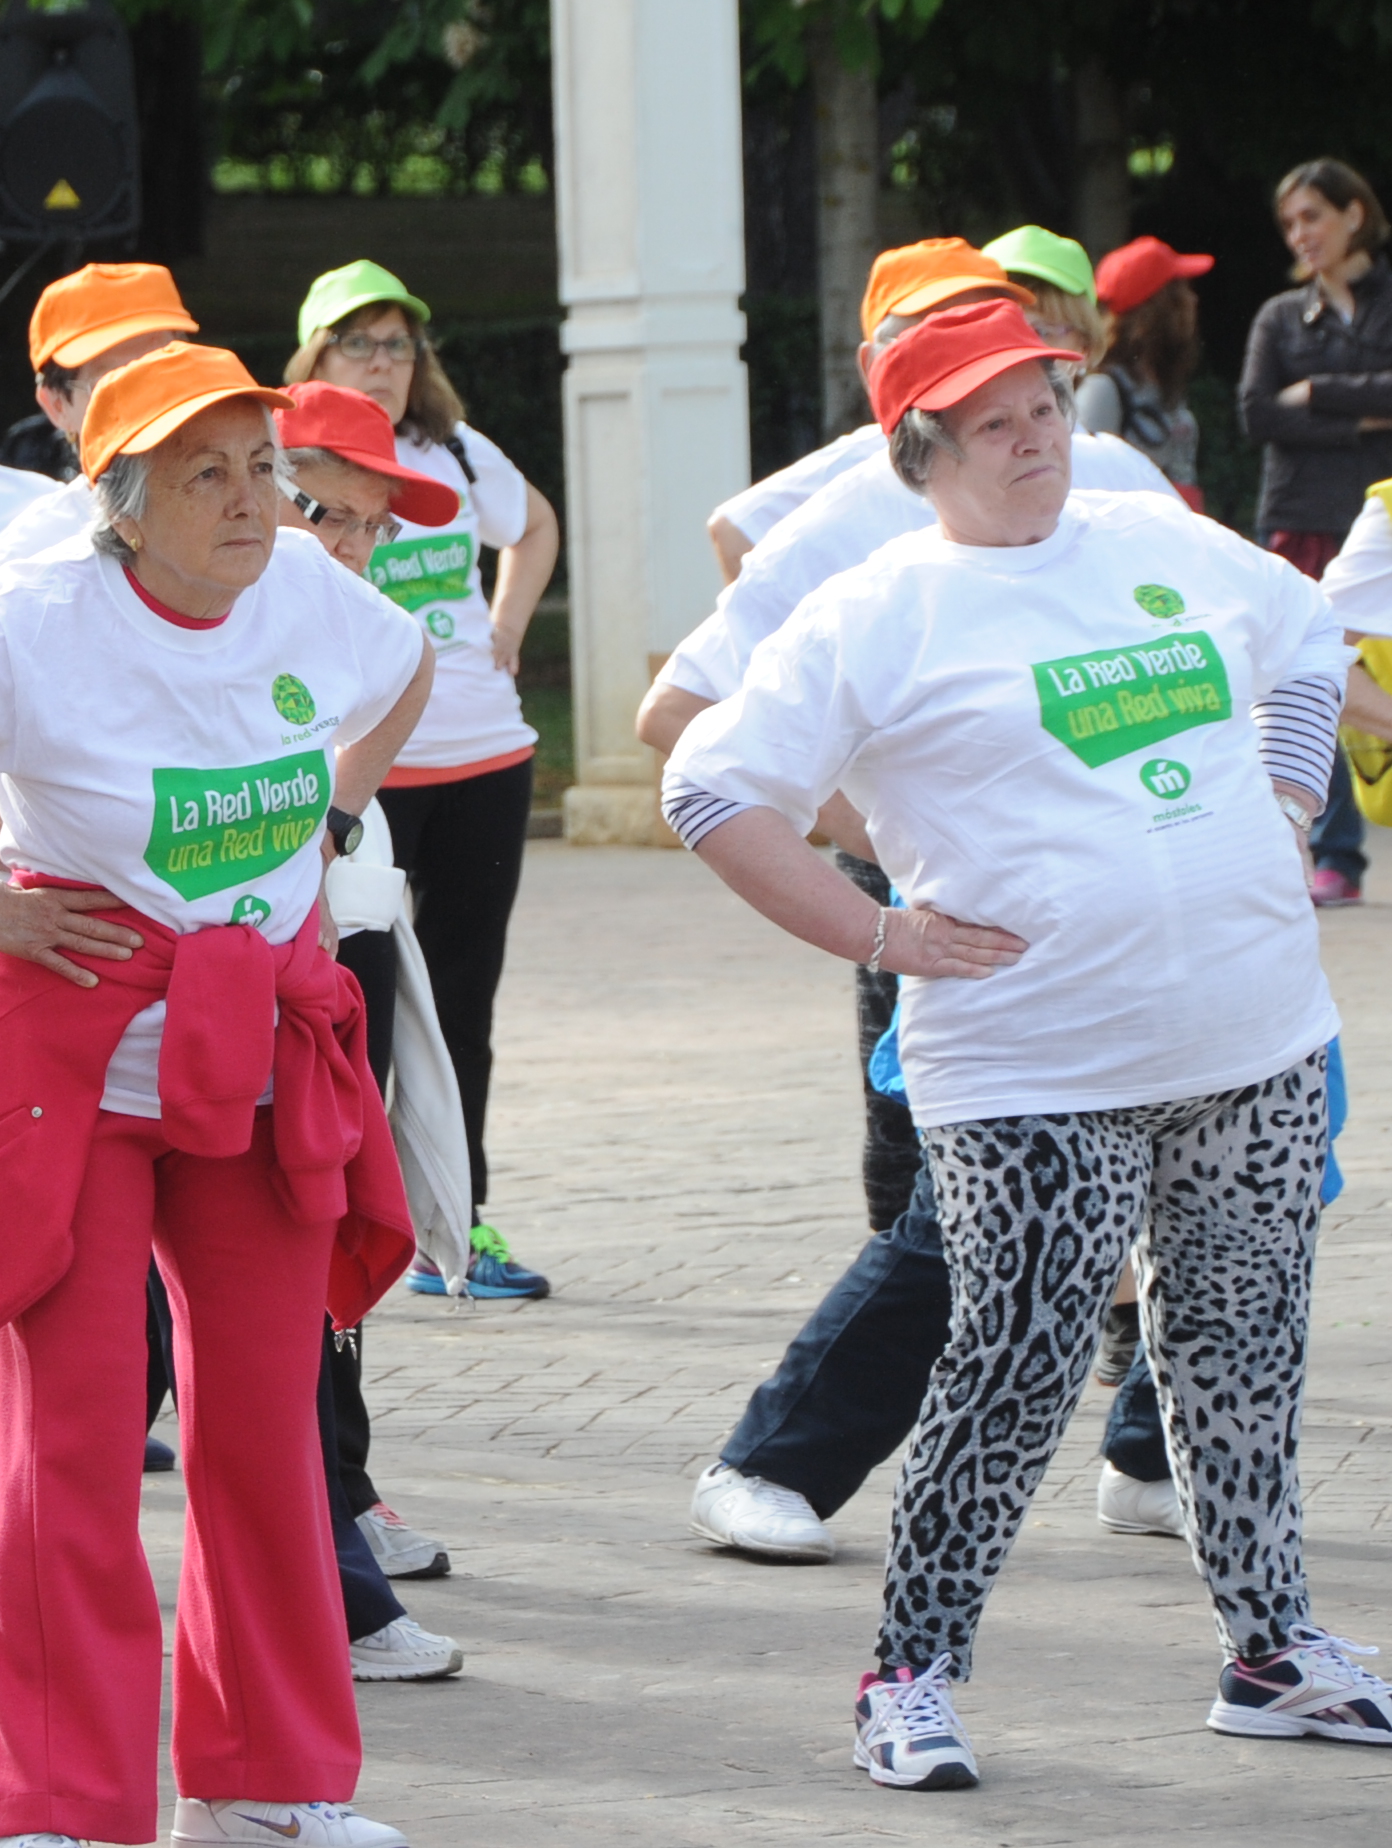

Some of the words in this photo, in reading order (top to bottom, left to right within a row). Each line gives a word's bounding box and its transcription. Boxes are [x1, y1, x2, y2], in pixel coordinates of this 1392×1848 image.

[1048, 667, 1087, 697] La
[1083, 653, 1137, 690] Red
[1132, 640, 1208, 678] Verde
[1067, 701, 1120, 740] una
[1116, 683, 1170, 726] Red
[1167, 678, 1222, 716] viva
[169, 795, 200, 834] La
[204, 781, 252, 828] Red
[255, 767, 320, 815] Verde
[166, 839, 213, 873] una
[219, 821, 265, 863] Red
[272, 815, 316, 852] viva
